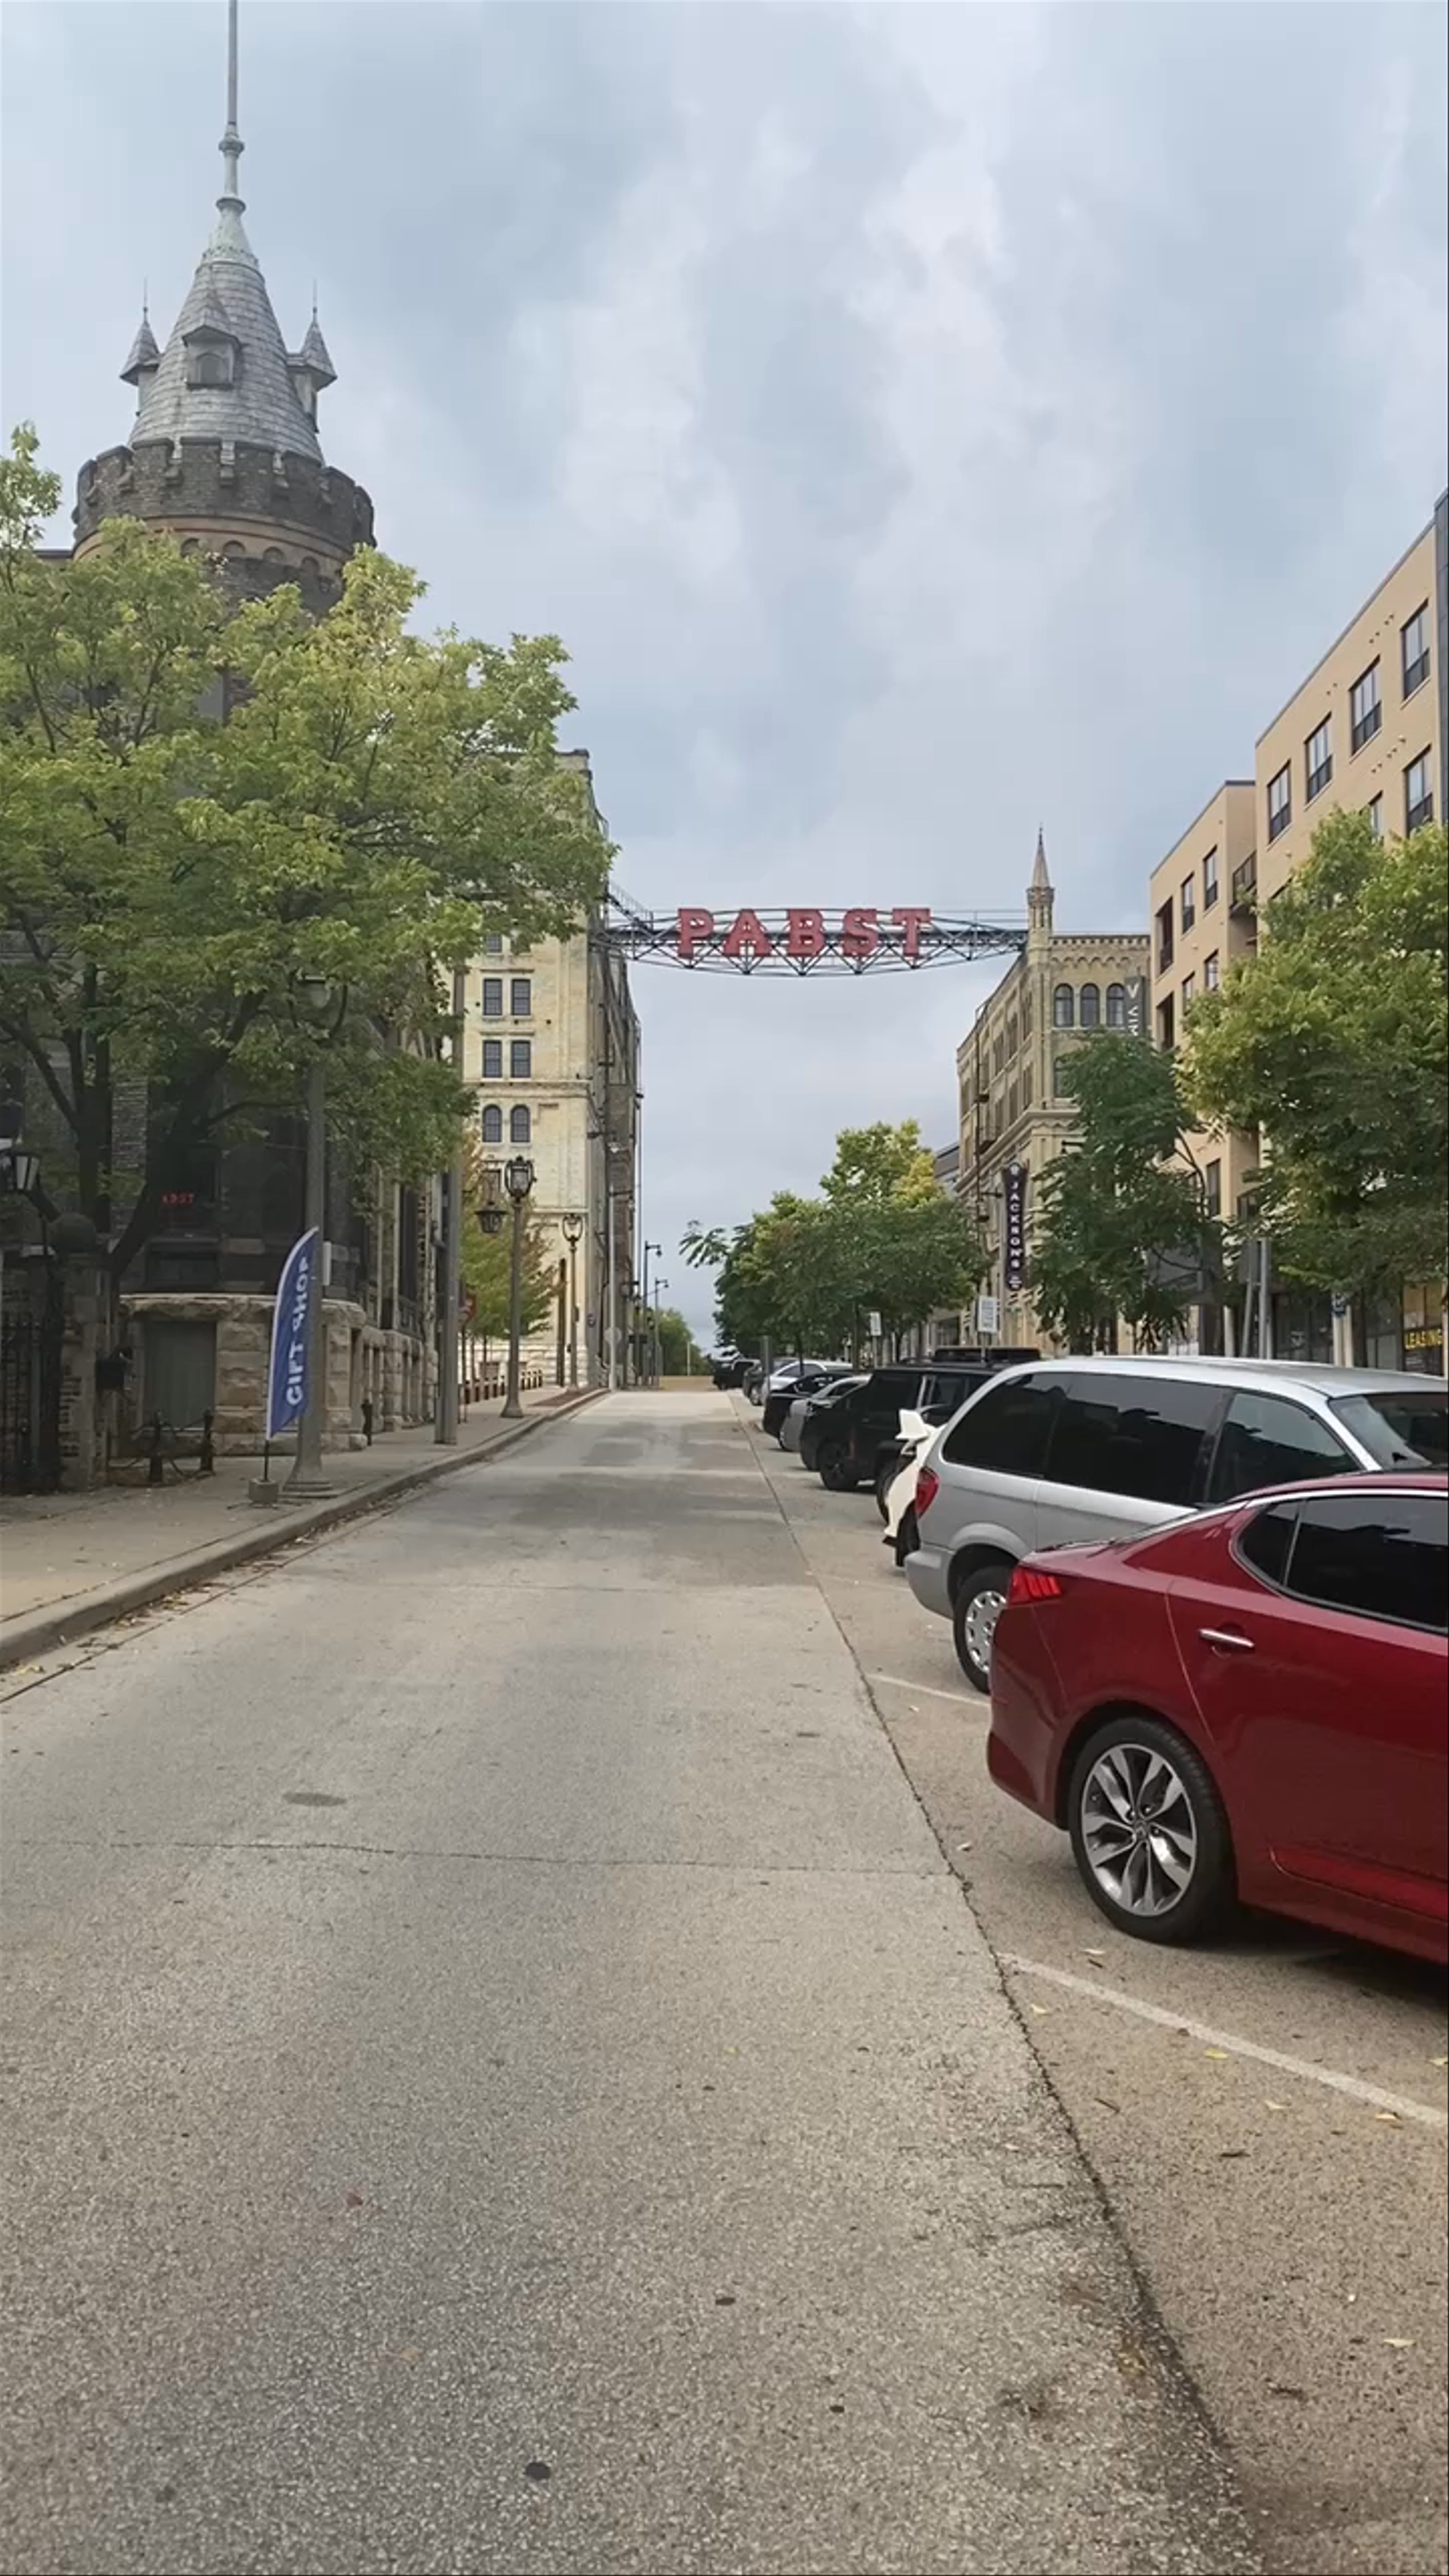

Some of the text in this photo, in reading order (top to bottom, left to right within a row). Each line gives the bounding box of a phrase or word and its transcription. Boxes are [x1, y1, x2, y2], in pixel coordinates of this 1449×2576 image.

[677, 908, 931, 959] PABST
[1126, 983, 1139, 998] V
[1404, 1329, 1443, 1350] LEASING
[286, 1342, 304, 1404] GIFT
